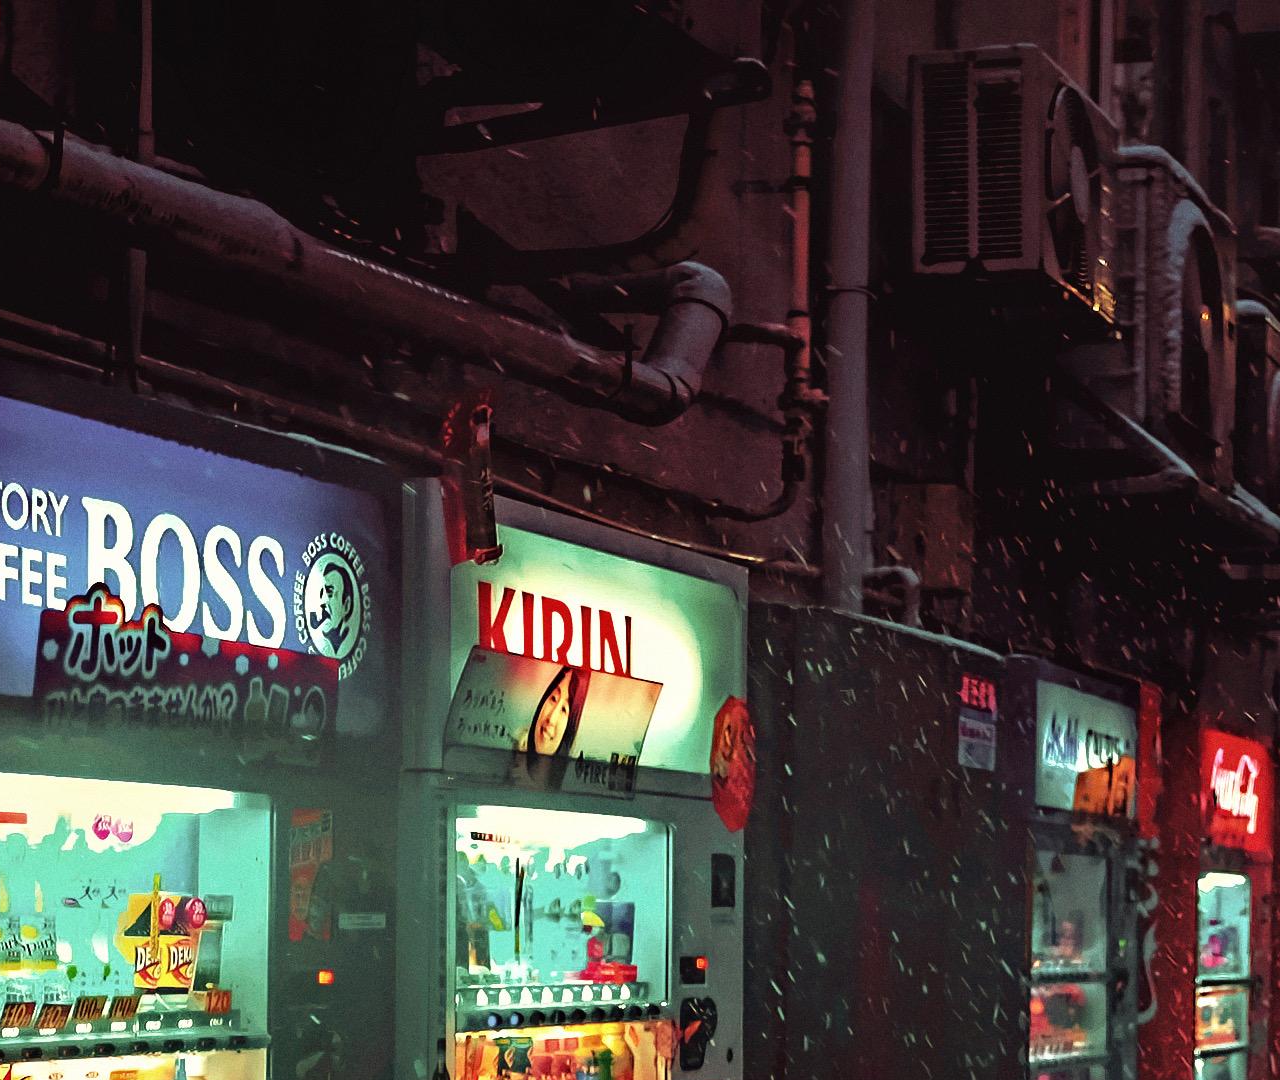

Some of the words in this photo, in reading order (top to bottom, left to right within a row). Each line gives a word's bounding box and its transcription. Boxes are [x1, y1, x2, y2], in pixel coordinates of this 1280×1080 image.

[81, 496, 286, 649] BOSS
[302, 533, 327, 567] BOSS
[330, 532, 366, 577] COFFEE
[65, 587, 169, 677] ホット
[293, 570, 308, 645] COFFEE
[361, 584, 371, 632] BOSS
[478, 581, 631, 678] KIRIN
[338, 637, 367, 681] COFFE
